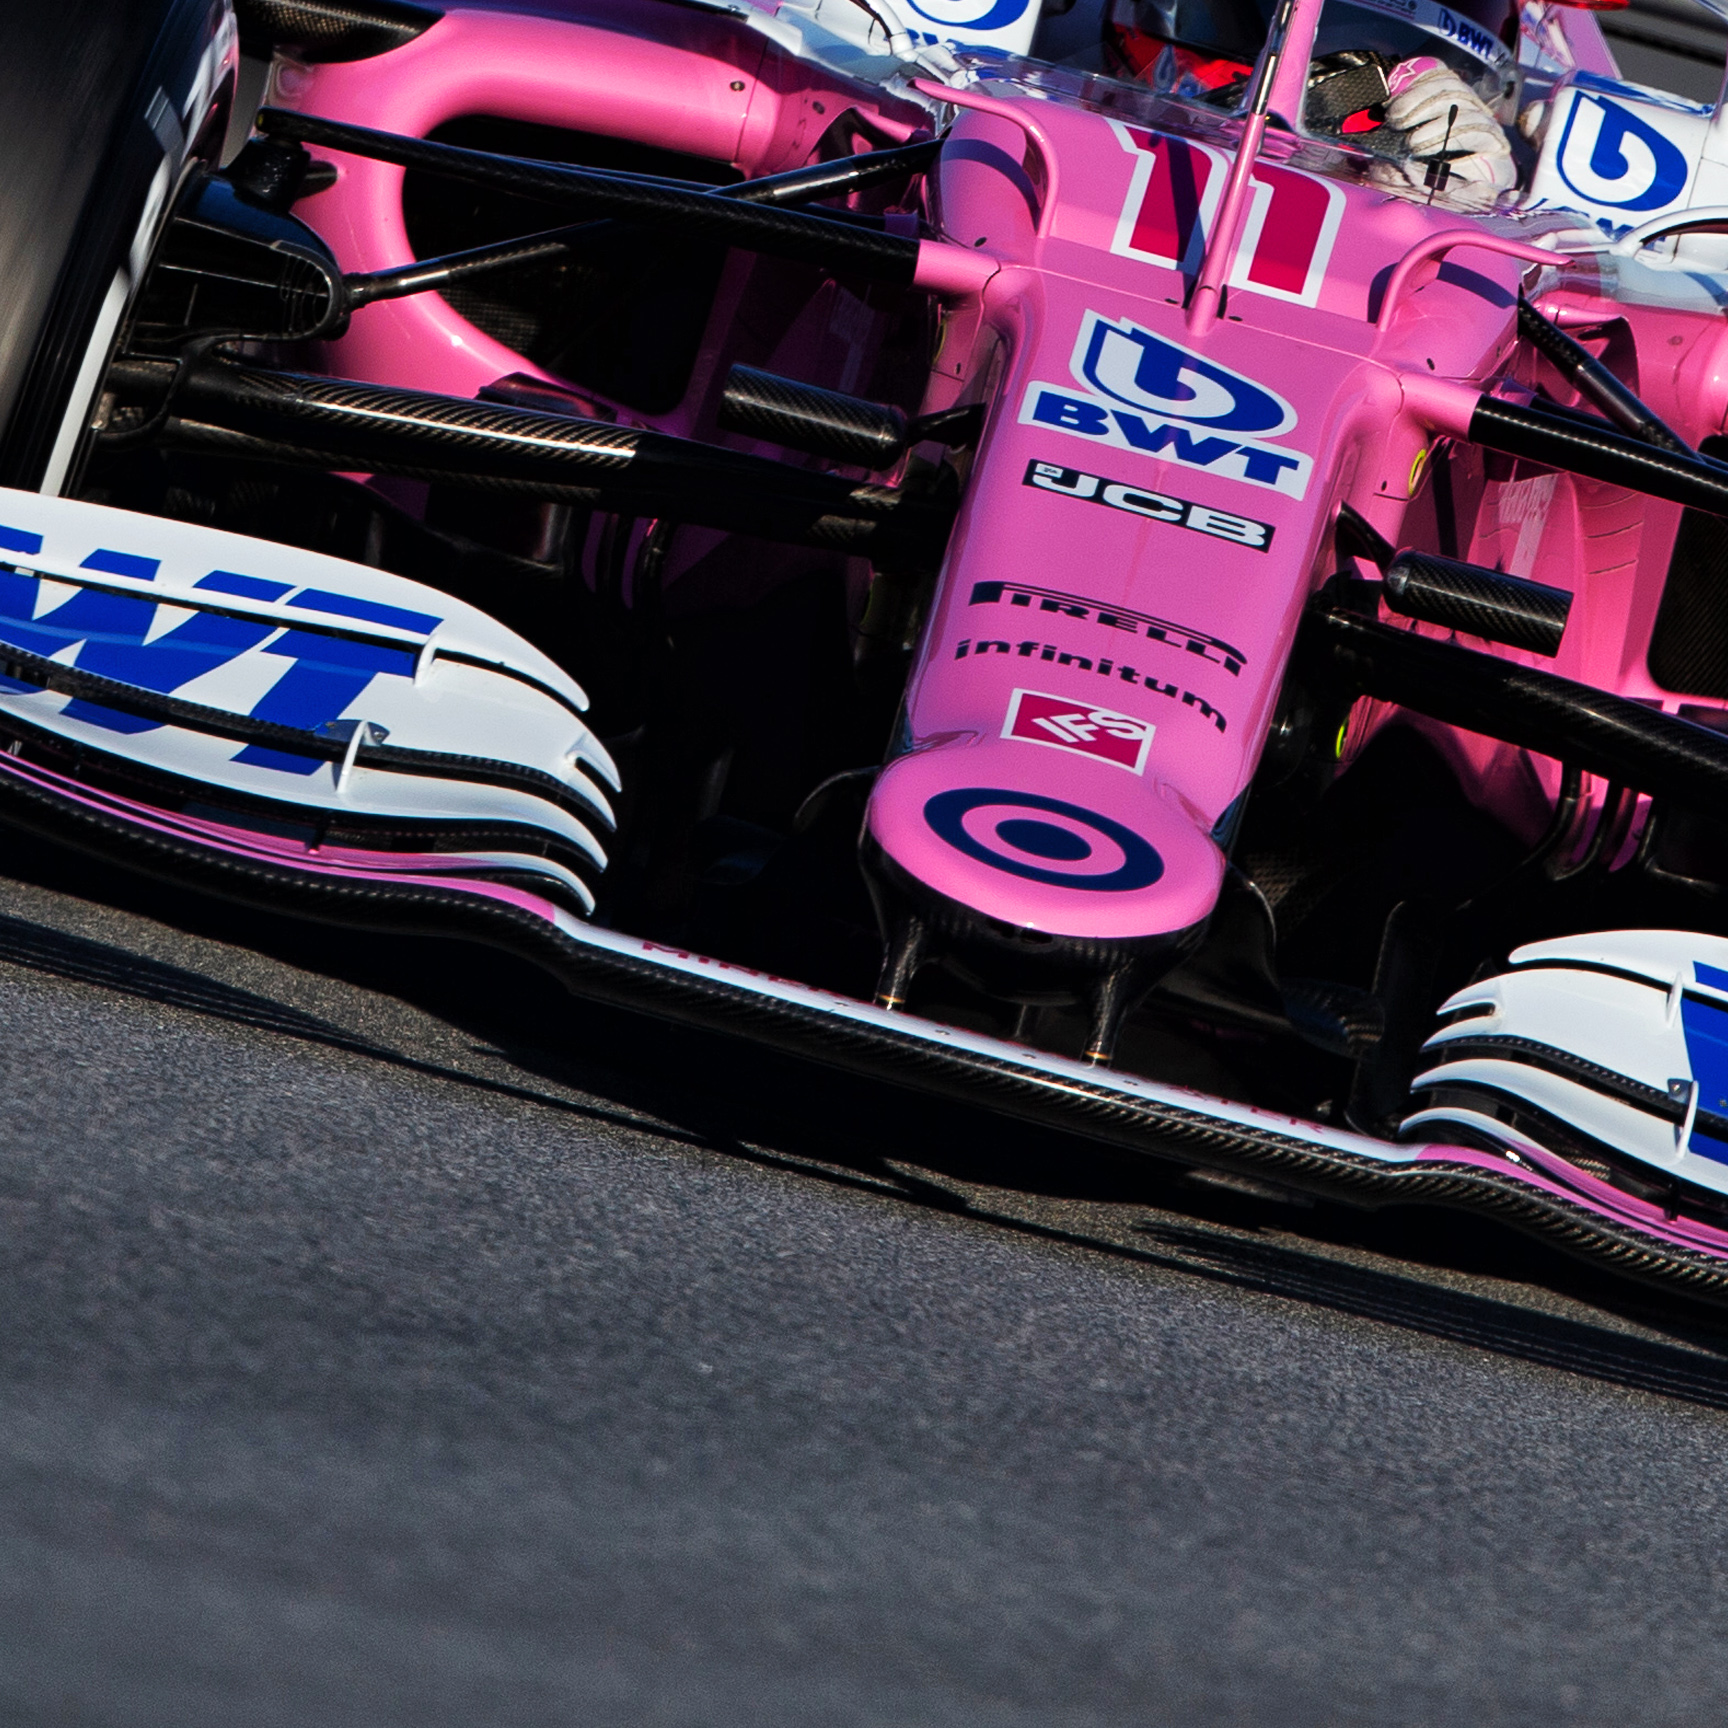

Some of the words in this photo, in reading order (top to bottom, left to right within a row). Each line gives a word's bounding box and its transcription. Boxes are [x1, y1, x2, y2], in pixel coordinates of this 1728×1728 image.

[1457, 21, 1495, 61] BWT
[1106, 118, 1346, 308] 11
[1030, 389, 1299, 486] BWT
[1031, 462, 1267, 548] JCB
[967, 579, 1249, 678] PIRELLI
[953, 638, 1228, 735] infinitum
